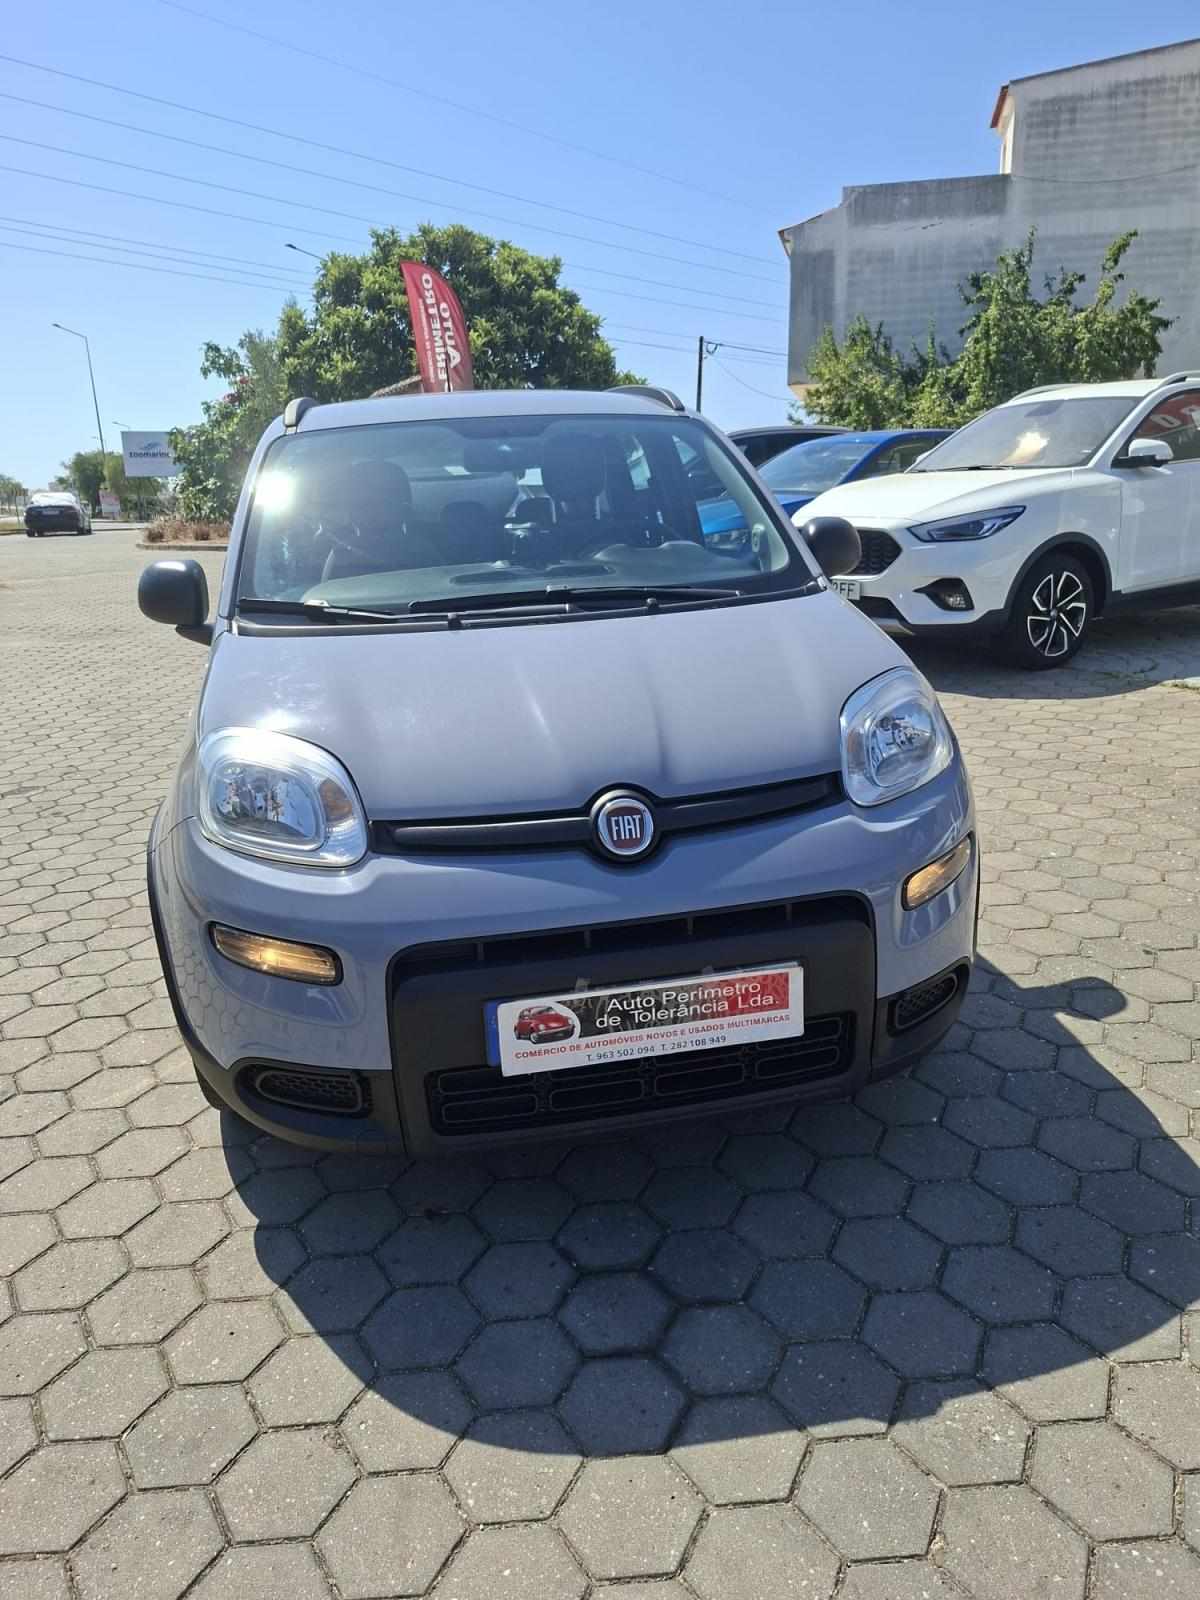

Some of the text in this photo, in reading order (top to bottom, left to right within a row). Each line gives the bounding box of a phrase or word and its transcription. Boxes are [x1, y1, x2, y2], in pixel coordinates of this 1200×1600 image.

[611, 815, 641, 841] FIAT
[595, 994, 779, 1028] de Tolerância Lda.
[607, 996, 655, 1012] Auto
[569, 1044, 580, 1053] DE
[646, 1030, 679, 1041] NOVOS
[688, 1024, 725, 1035] USADOS
[727, 1015, 790, 1028] MULTIMARCAS
[597, 1051, 614, 1060] 963
[617, 1048, 635, 1057] 502
[637, 1046, 655, 1055] 094
[671, 1041, 687, 1050] 282
[690, 1038, 707, 1047] 108
[709, 1035, 727, 1044] 949
